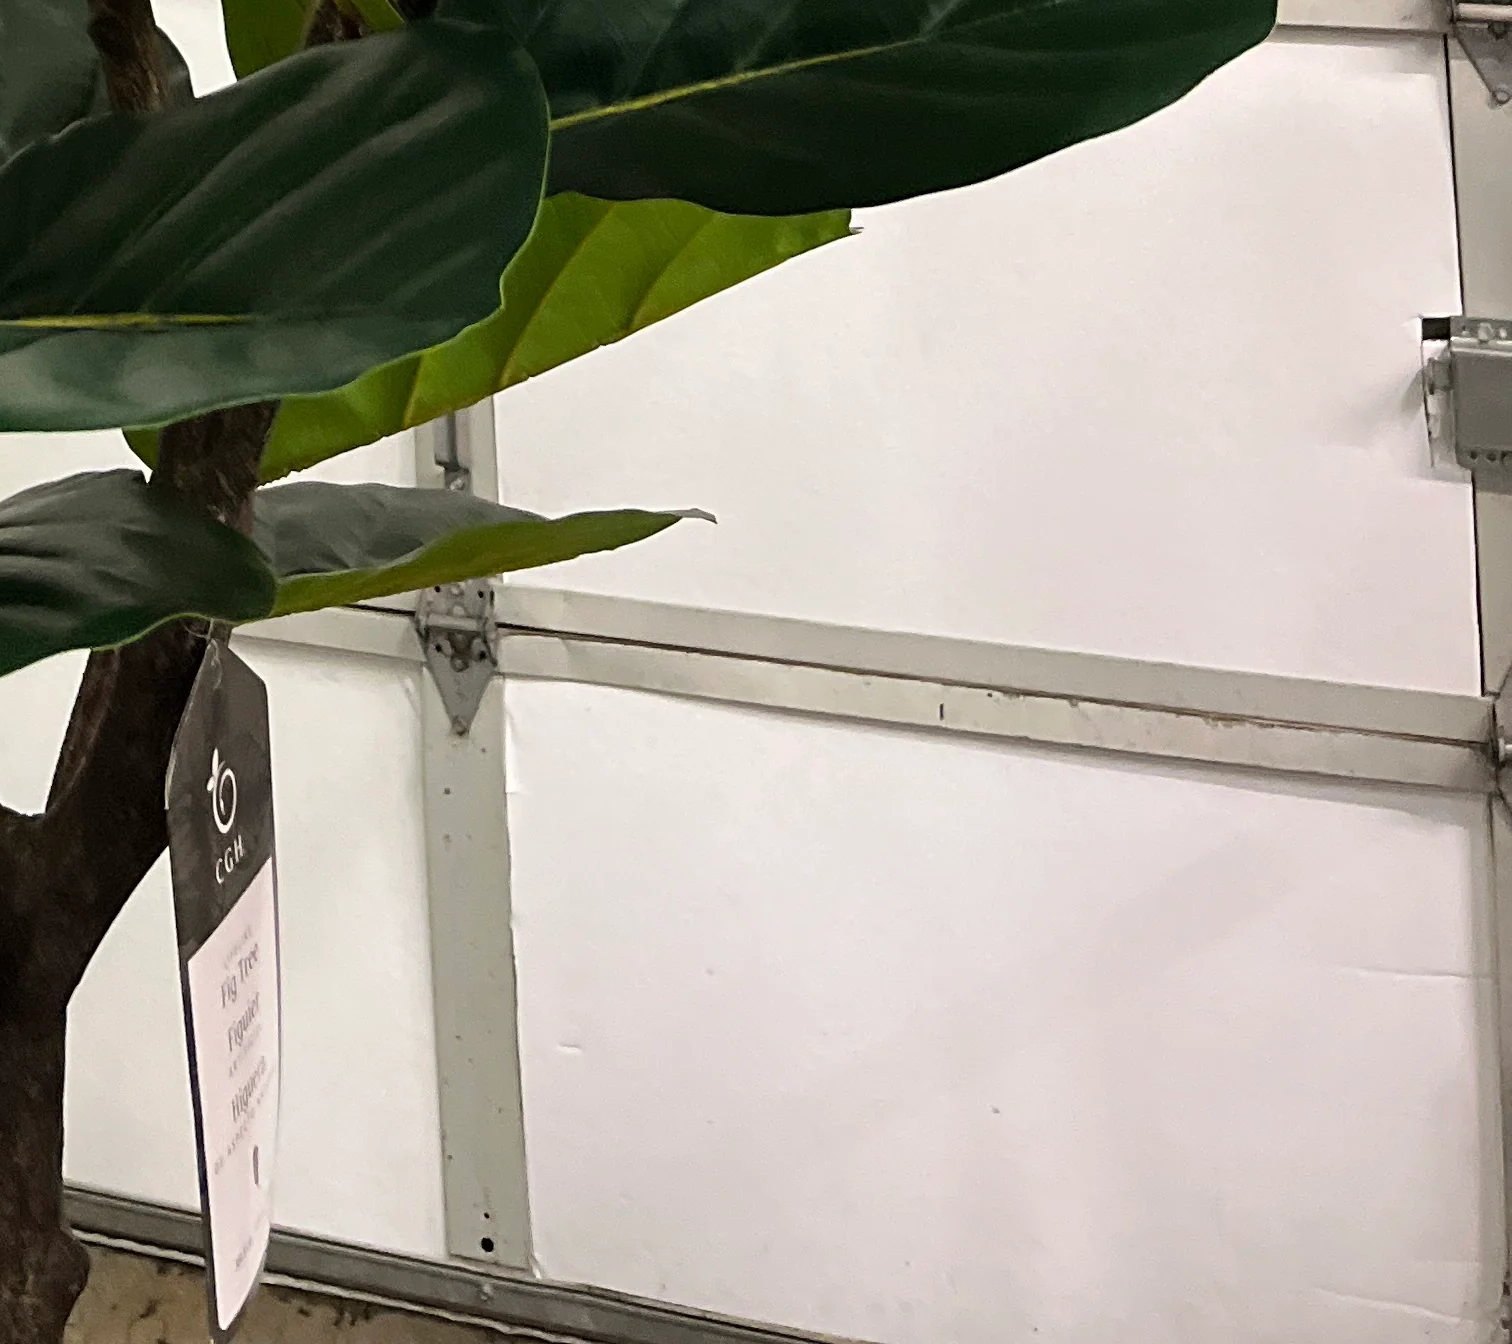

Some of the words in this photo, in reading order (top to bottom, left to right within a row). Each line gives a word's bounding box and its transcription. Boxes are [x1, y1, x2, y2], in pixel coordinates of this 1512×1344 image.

[216, 834, 243, 884] CGH
[221, 975, 237, 1009] Fig
[238, 943, 258, 982] Tree
